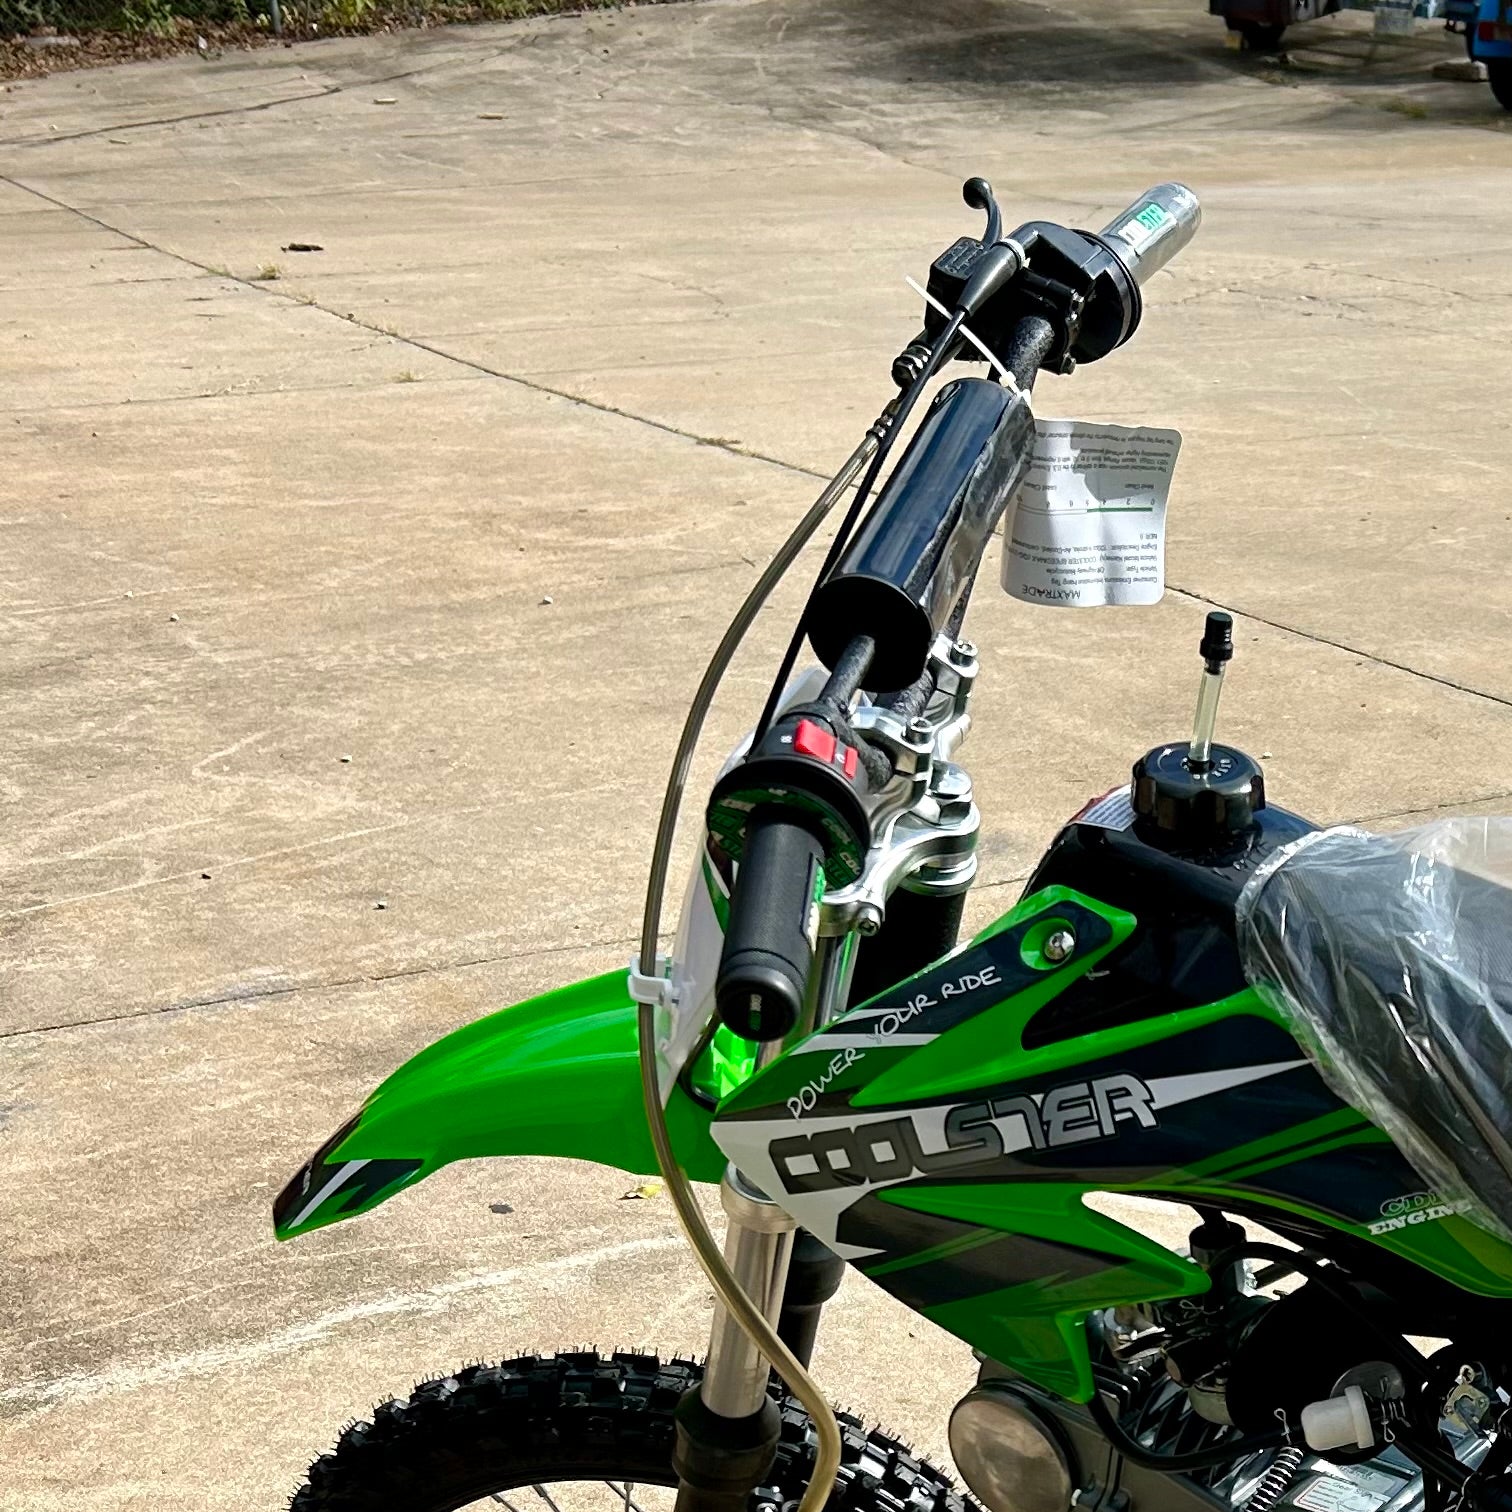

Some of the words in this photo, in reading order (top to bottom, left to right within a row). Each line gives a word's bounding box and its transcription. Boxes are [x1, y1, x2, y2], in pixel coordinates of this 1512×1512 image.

[1022, 584, 1081, 600] MAXTRADE
[786, 1047, 865, 1120] POWER
[866, 994, 938, 1044] YOUR
[941, 965, 1002, 999] RIDE
[769, 1071, 1160, 1195] COOLSTER
